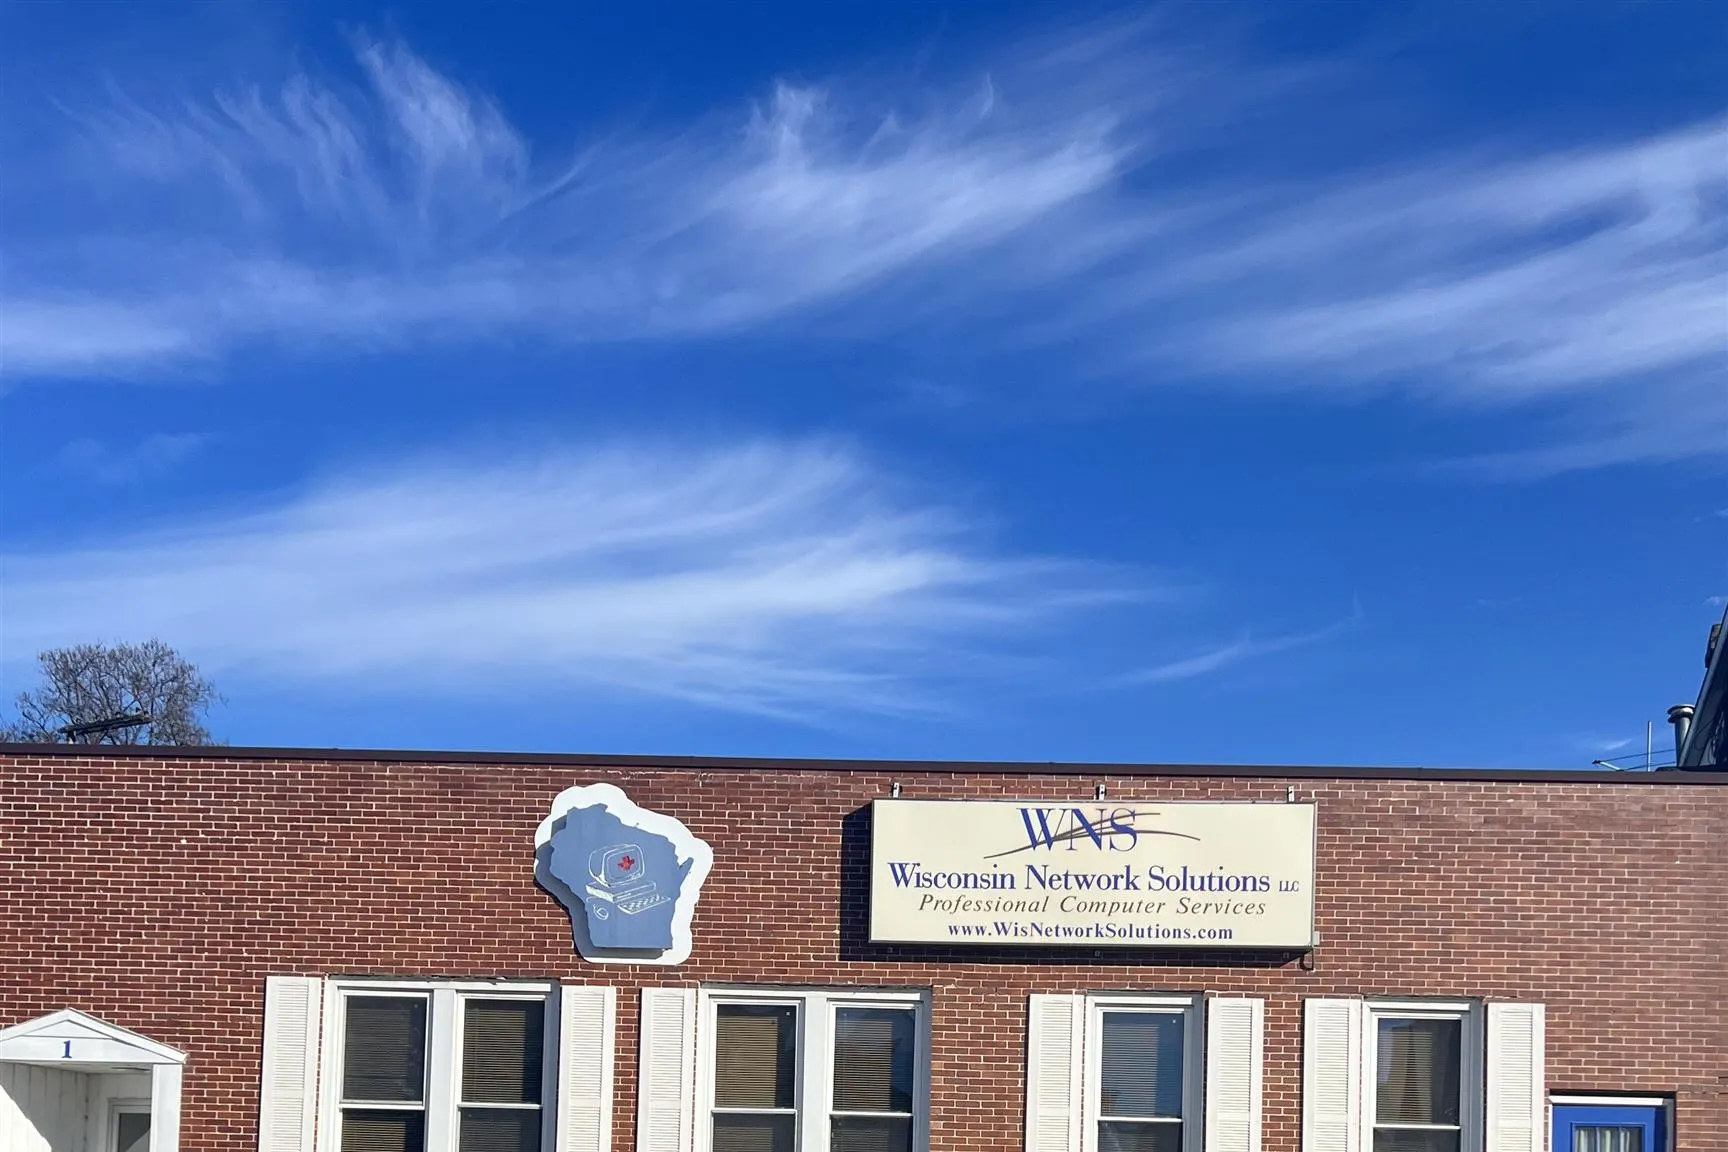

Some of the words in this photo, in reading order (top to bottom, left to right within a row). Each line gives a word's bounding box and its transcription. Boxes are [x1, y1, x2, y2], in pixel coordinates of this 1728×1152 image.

[1016, 808, 1137, 852] WNS
[888, 863, 1016, 889] Wisconsin
[1025, 864, 1141, 891] Network
[1147, 866, 1271, 892] Solutions
[1278, 880, 1300, 893] LLC
[919, 894, 1050, 914] Professional
[1060, 895, 1166, 917] Computer
[1176, 897, 1267, 916] Services
[948, 922, 1234, 940] www.WisNetworkSolutions.com
[61, 1040, 72, 1059] 1
